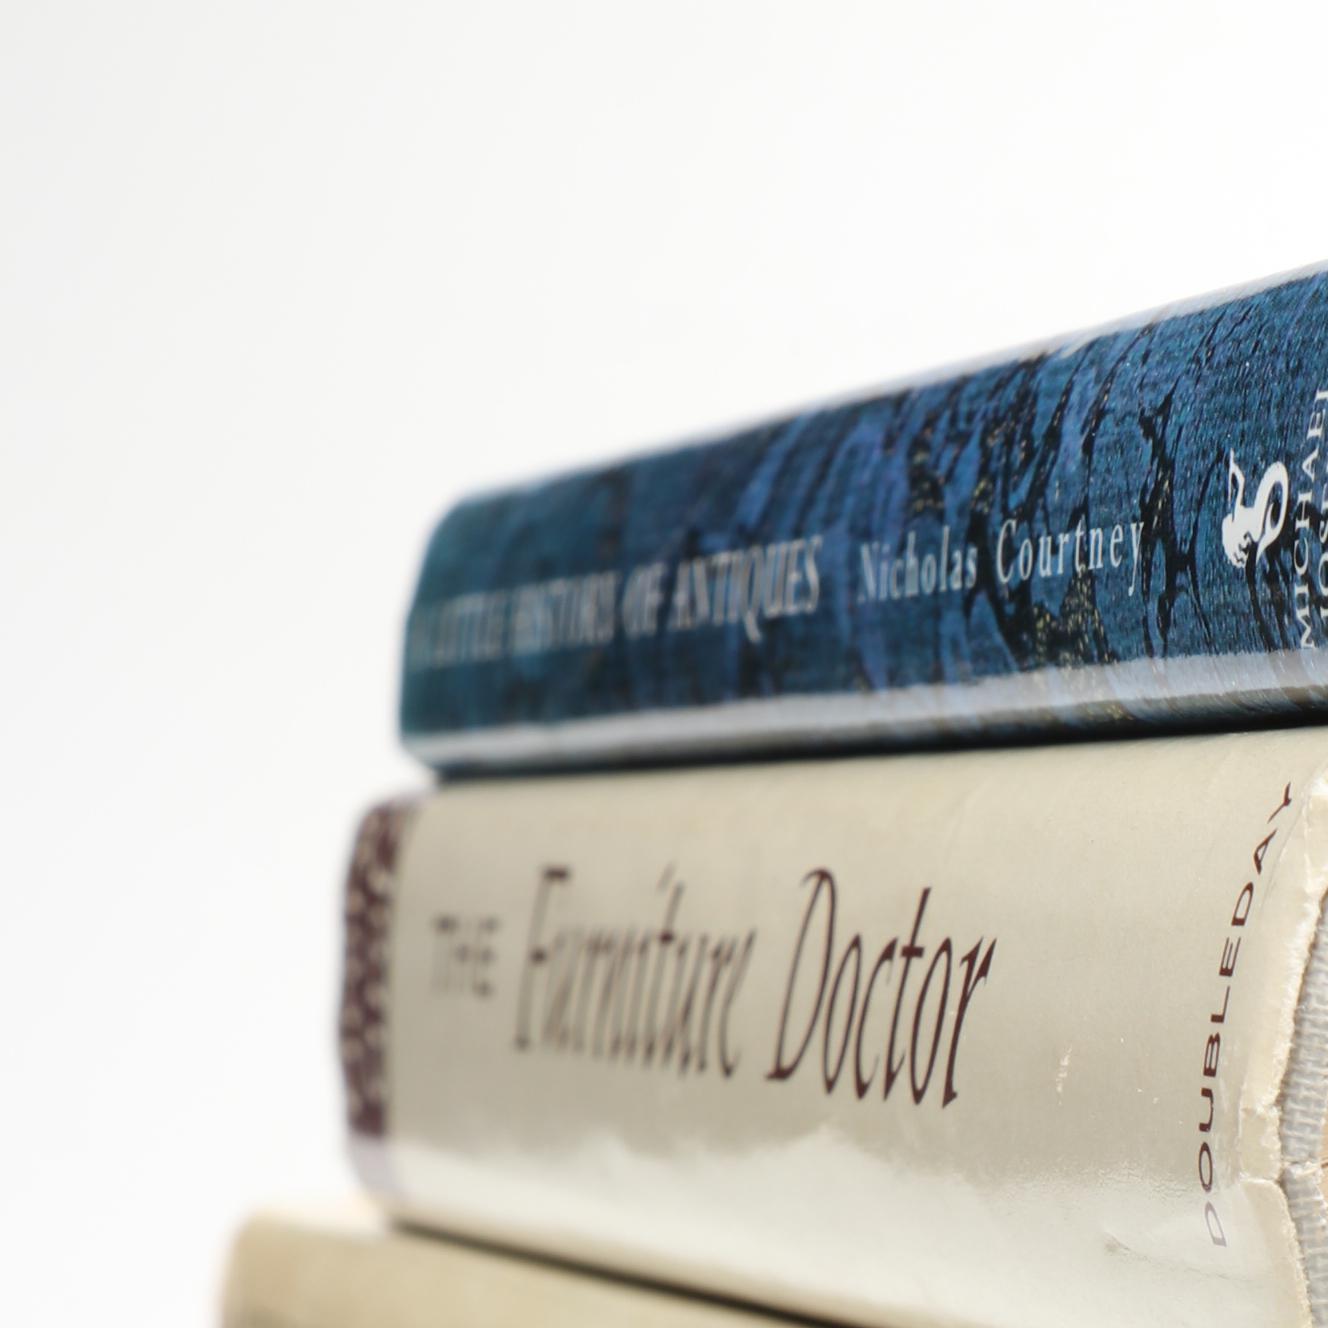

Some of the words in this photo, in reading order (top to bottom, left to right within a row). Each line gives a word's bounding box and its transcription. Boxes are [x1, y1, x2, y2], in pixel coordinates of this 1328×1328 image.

[622, 562, 666, 639] OF
[669, 534, 823, 644] ANTIQUES
[857, 525, 978, 603] Nicholas
[997, 517, 1146, 597] Courtney
[513, 862, 757, 1081] Furniture
[764, 866, 998, 1109] Doctor
[1197, 781, 1292, 1248] DOUBLEDAY
